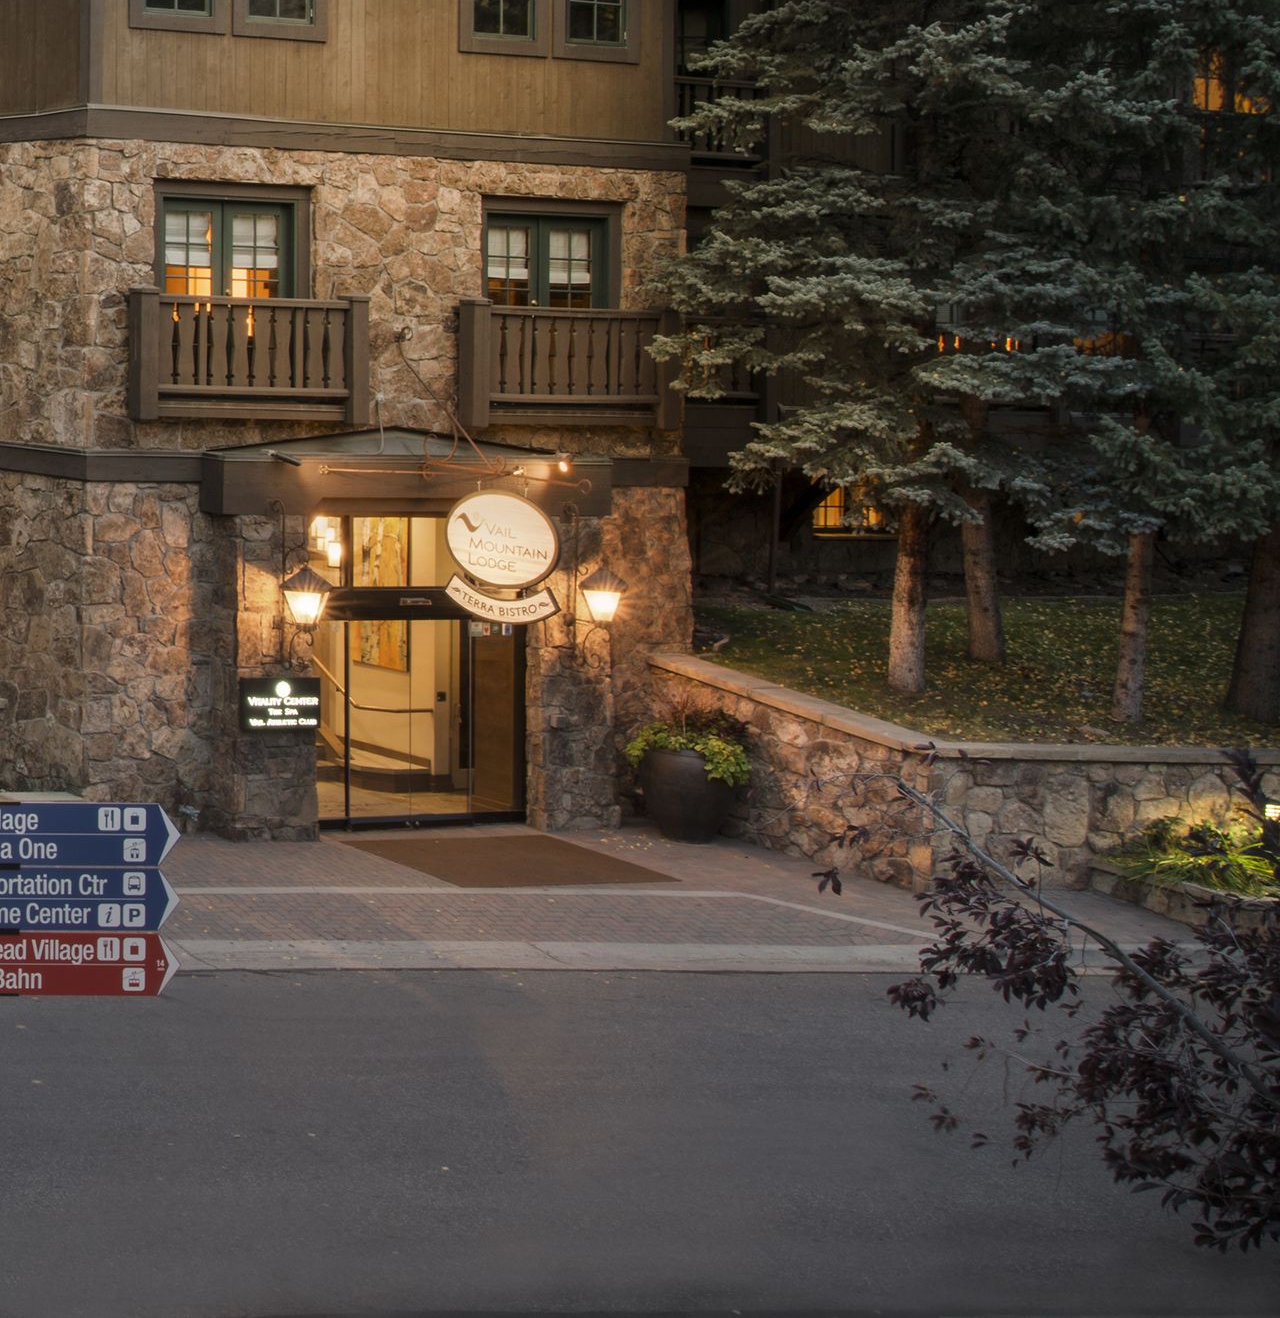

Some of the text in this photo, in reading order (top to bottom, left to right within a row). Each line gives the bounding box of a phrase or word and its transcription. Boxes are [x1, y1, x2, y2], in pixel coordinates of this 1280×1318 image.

[484, 521, 517, 539] VAIL
[468, 537, 548, 560] MOUNTAIN
[468, 552, 517, 572] LODGE
[461, 590, 538, 617] TERRA BISTRO
[283, 696, 319, 706] CENTER
[19, 838, 58, 859] One
[78, 874, 108, 895] Ctr
[26, 902, 92, 924] Center
[128, 908, 141, 923] P
[32, 938, 94, 964] Village
